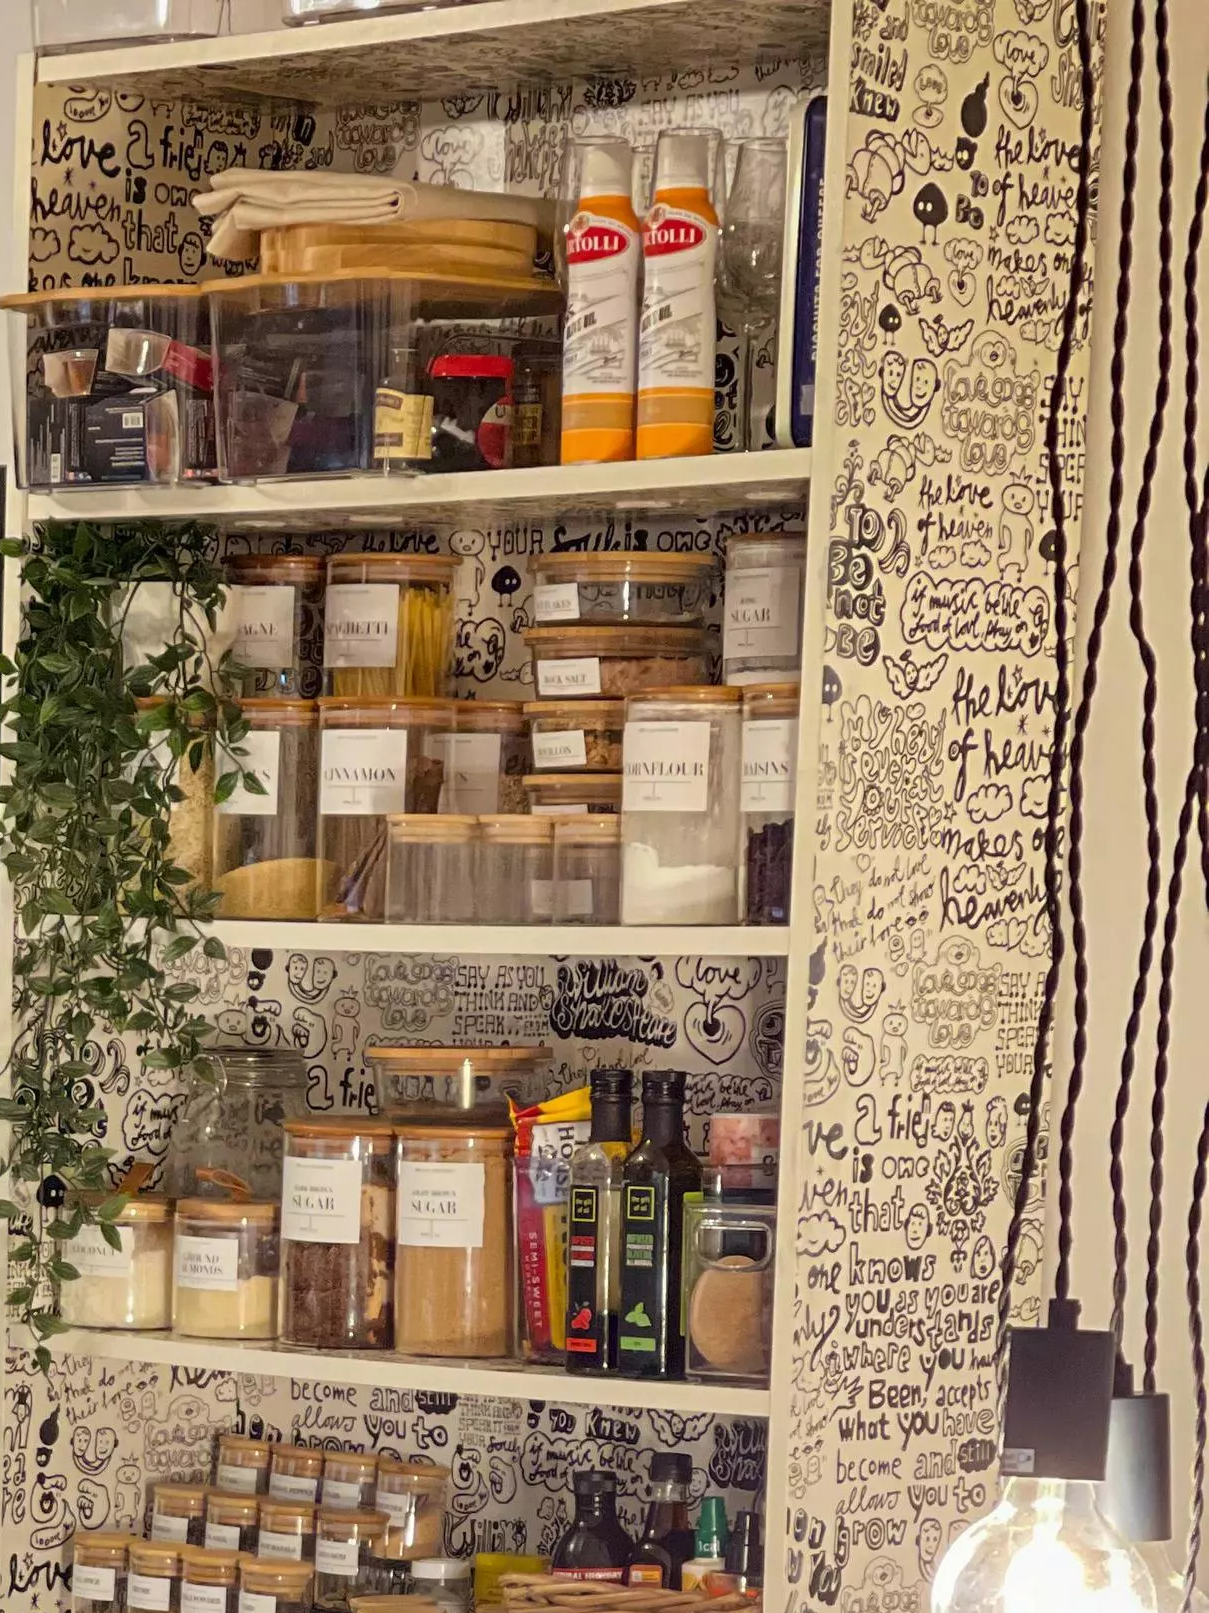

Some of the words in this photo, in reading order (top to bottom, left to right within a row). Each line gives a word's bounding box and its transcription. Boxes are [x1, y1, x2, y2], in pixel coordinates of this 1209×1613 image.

[1018, 180, 1085, 211] heave
[731, 608, 770, 622] SUGAR
[996, 1027, 1035, 1050] SPEA
[293, 1196, 334, 1210] SUGAR
[412, 1201, 456, 1214] SUGAR
[528, 1231, 543, 1328] SEMI-SWEET
